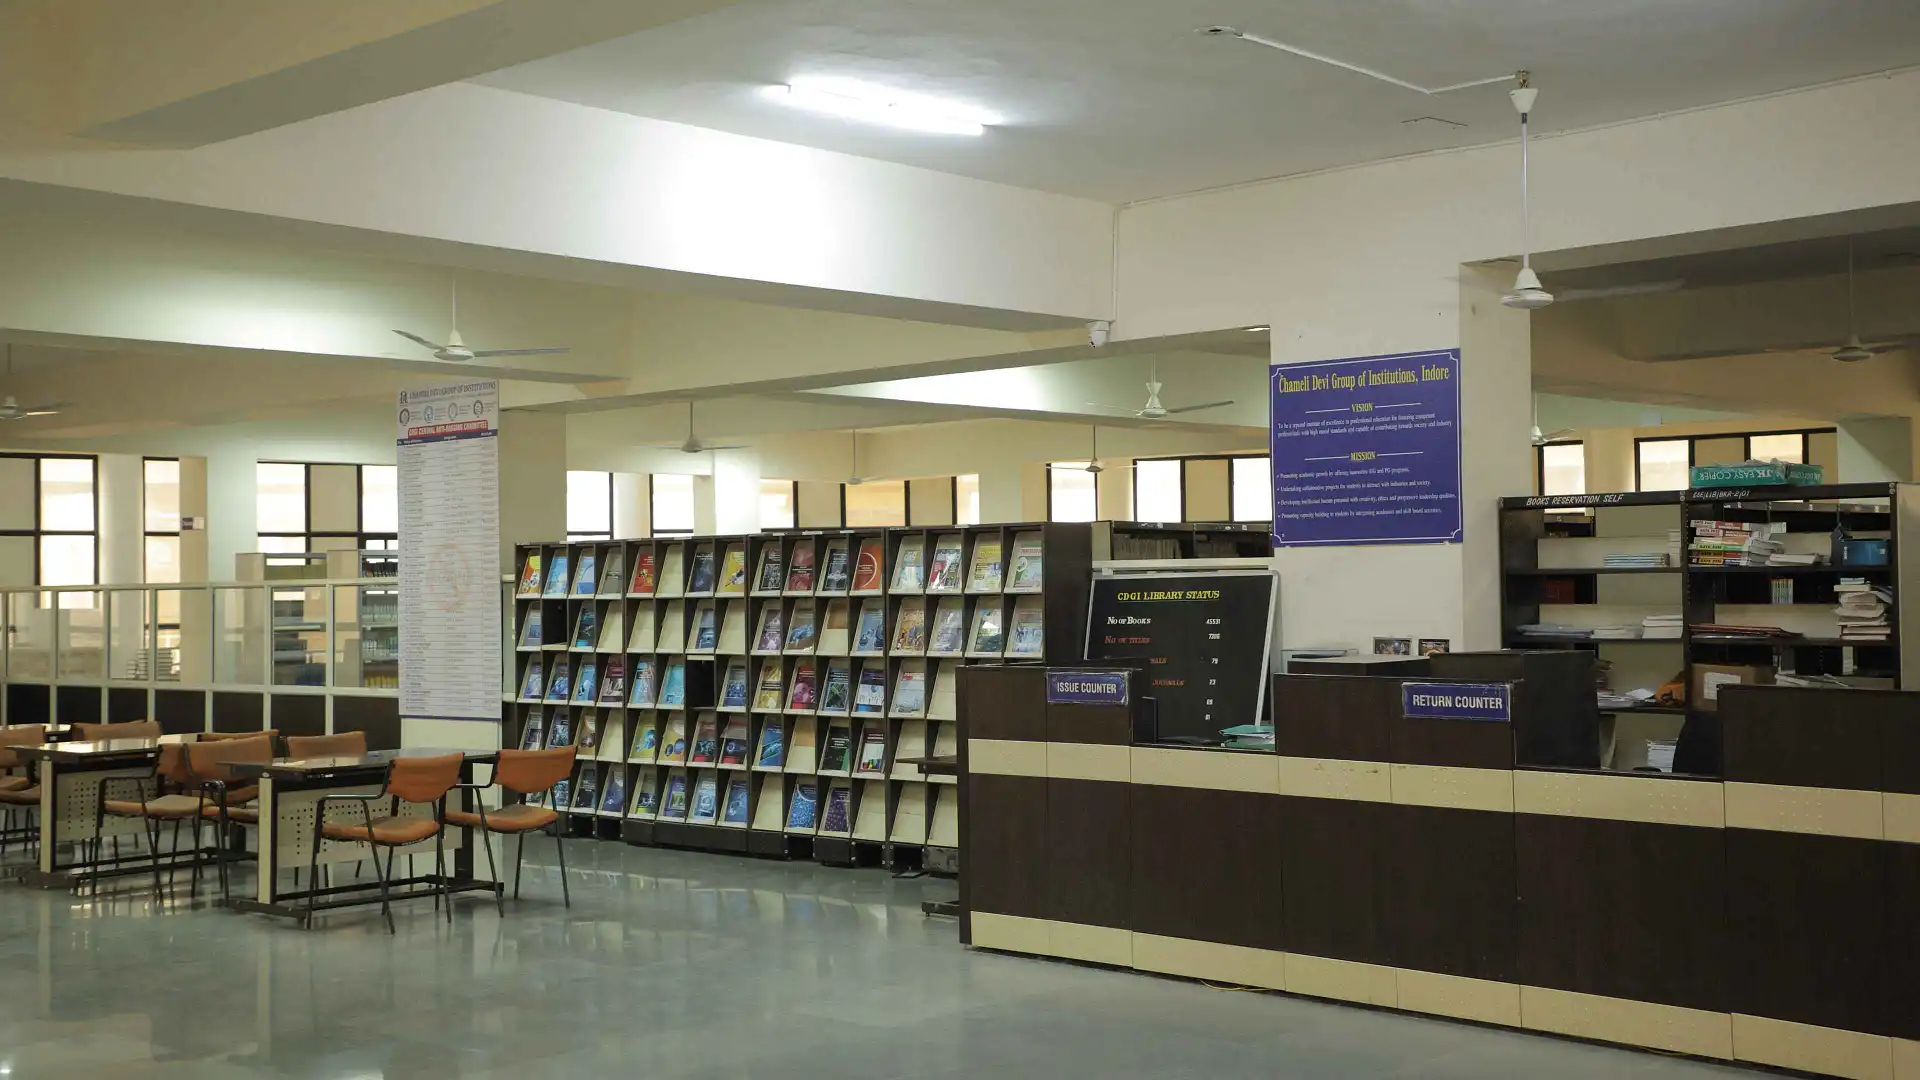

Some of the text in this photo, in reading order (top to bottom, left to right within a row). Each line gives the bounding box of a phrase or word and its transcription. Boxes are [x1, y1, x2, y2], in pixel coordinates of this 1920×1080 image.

[1279, 364, 1449, 394] Chameli Devi Group of Institutions, Indore
[1352, 403, 1373, 413] VISION
[1350, 452, 1376, 461] MISSION
[1699, 471, 1732, 481] COPIER
[1734, 470, 1755, 479] EASY
[1526, 494, 1625, 506] BOOKS RESERVATION SELF
[1144, 591, 1184, 600] LIBRARY
[1186, 591, 1220, 599] STATUS
[1057, 682, 1117, 694] ISSUE COUNTER
[1413, 695, 1503, 709] RETURN COUNTER
